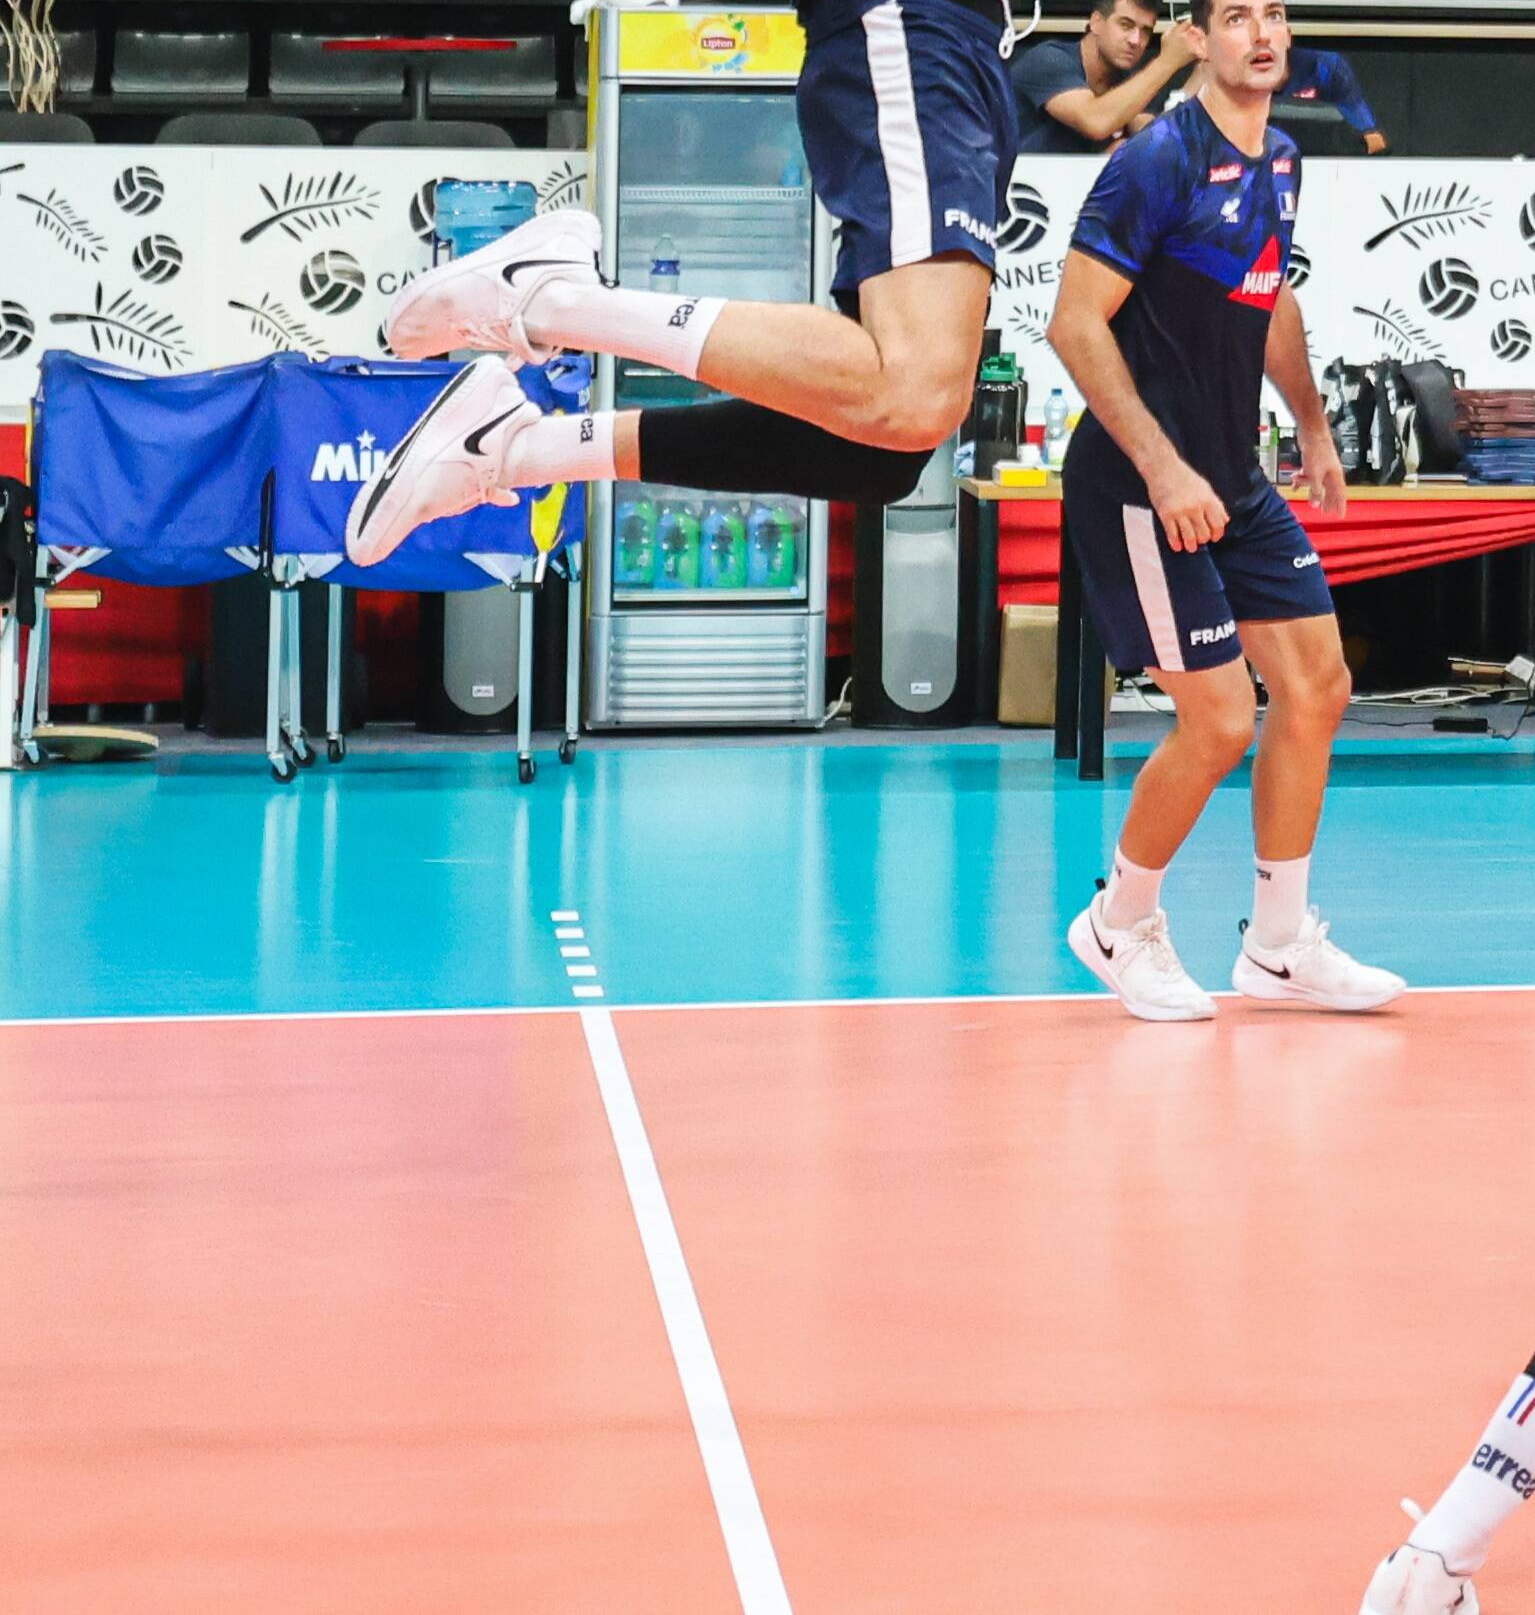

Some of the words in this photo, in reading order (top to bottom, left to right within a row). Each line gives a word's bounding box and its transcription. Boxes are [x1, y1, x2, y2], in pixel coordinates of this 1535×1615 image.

[702, 39, 734, 50] Lipton
[993, 260, 1066, 292] NNES
[1241, 271, 1282, 295] MAIF
[1190, 619, 1237, 646] FRAN
